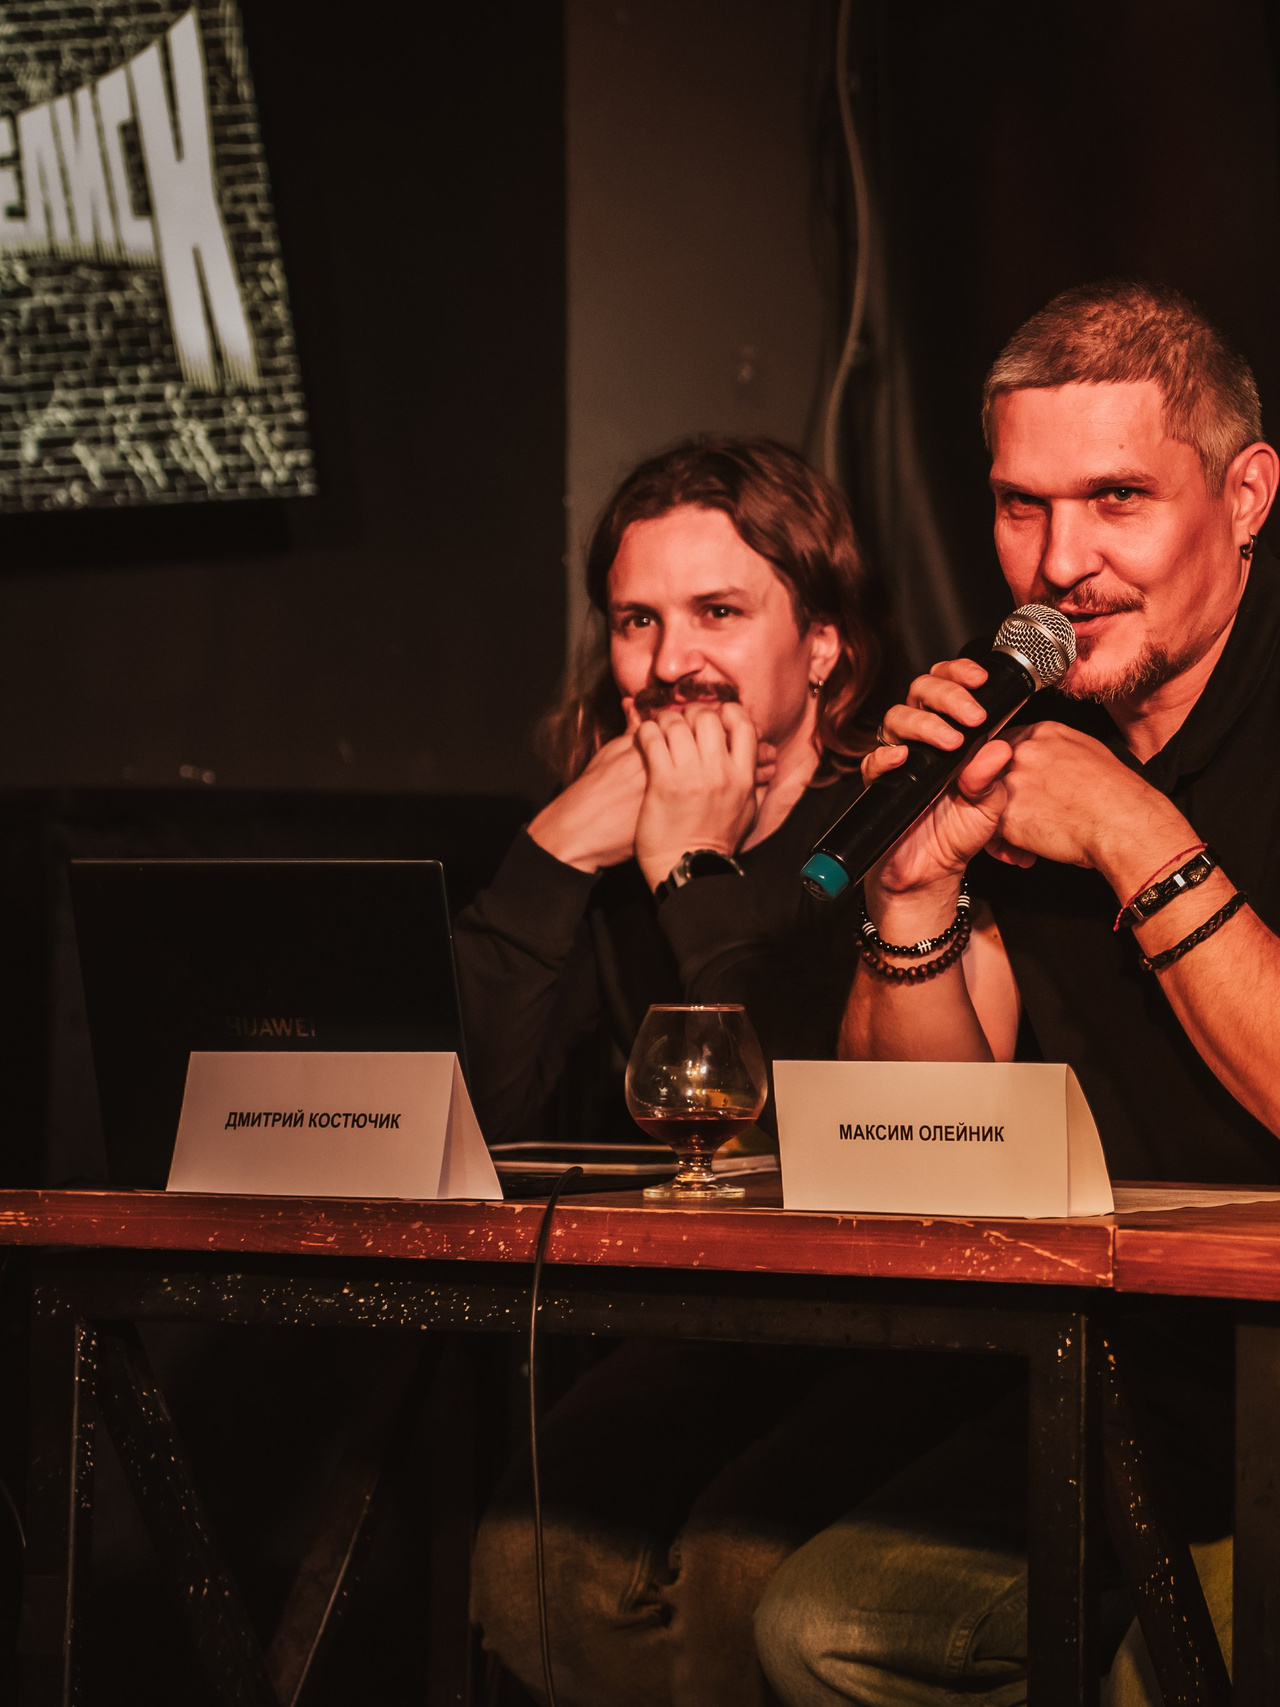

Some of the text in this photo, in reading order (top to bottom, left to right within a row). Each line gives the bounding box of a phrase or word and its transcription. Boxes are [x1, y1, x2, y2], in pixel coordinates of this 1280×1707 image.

[226, 1017, 317, 1037] HUAWEI
[225, 1109, 402, 1130] ДМИТРИЙ КОСТЮЧИК
[839, 1122, 1005, 1142] МАКСИМ ОЛЕЙНИК
